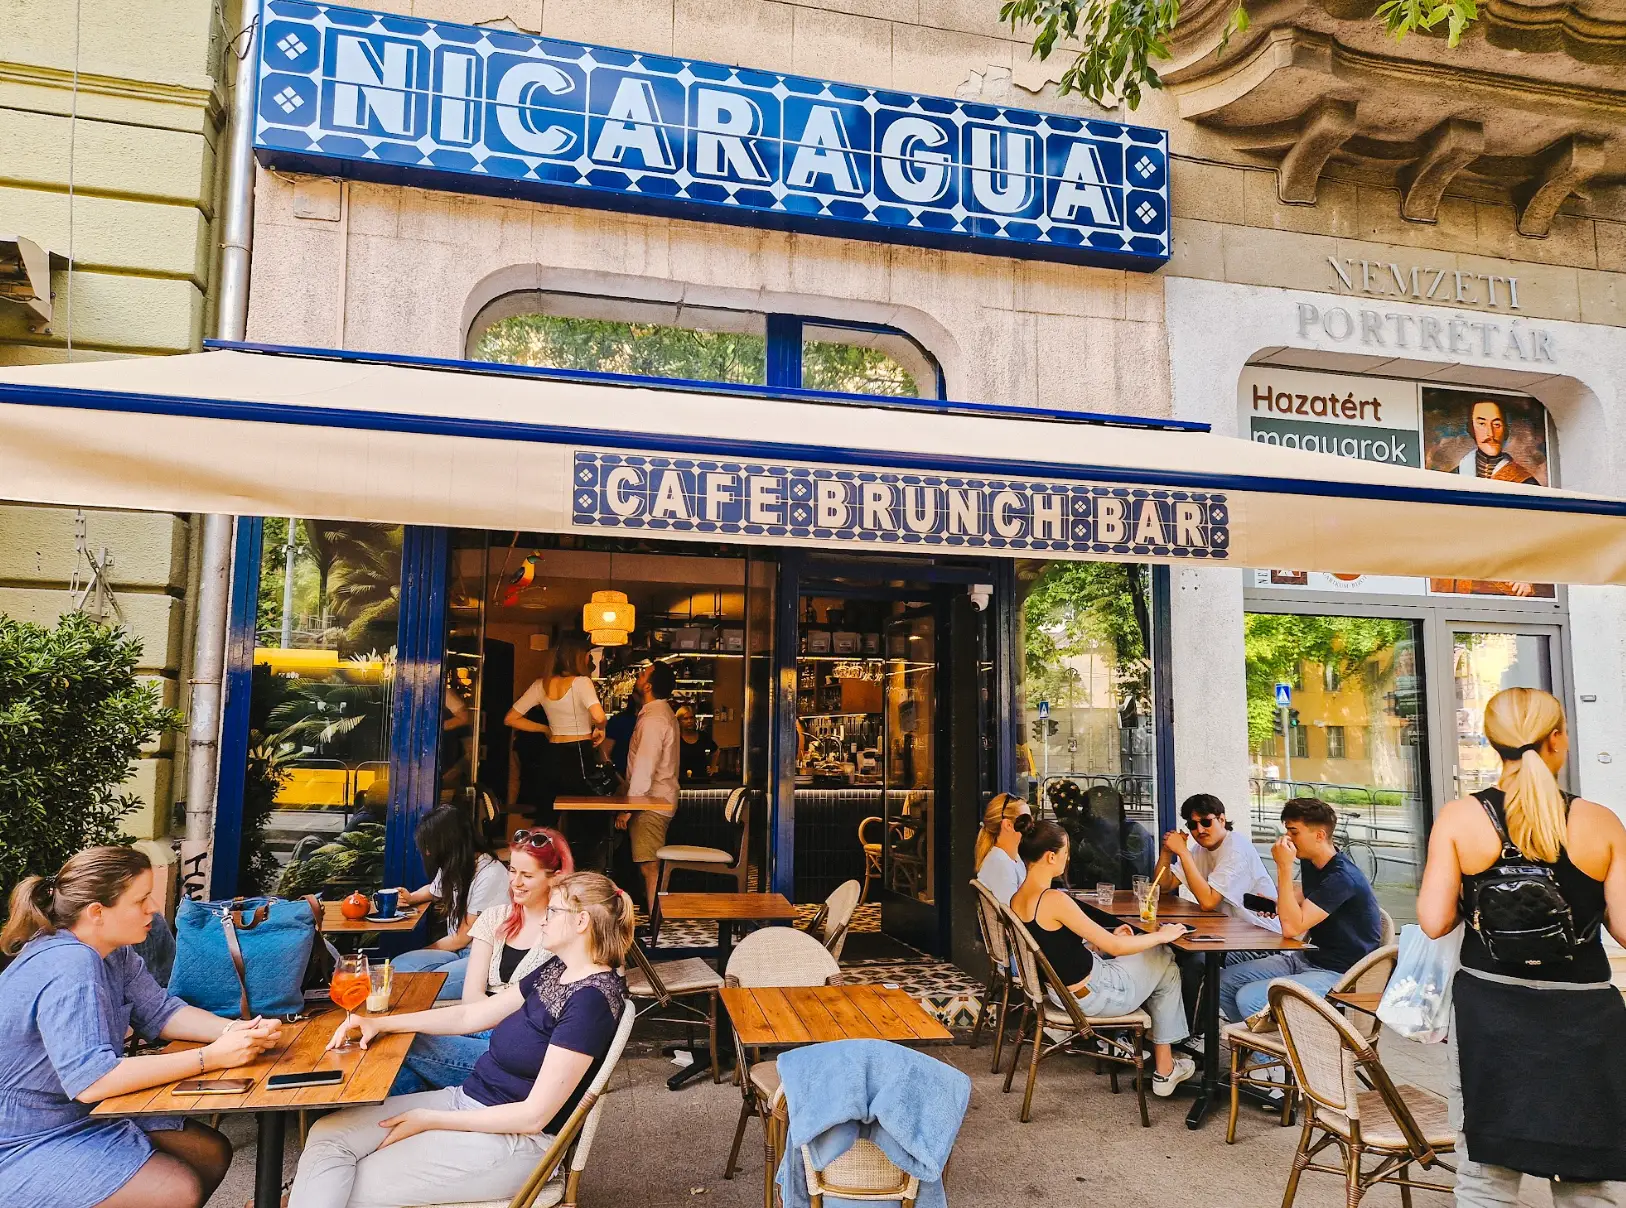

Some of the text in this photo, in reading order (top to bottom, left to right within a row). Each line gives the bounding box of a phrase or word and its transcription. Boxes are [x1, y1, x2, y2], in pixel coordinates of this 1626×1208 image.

[332, 34, 1120, 226] NICARAGUA
[1327, 256, 1521, 309] NEMZETI
[1294, 301, 1556, 364] PORTRÉTÁR
[1252, 384, 1382, 422] Hazatért
[606, 467, 1209, 548] CAFE BRUNCH BAR
